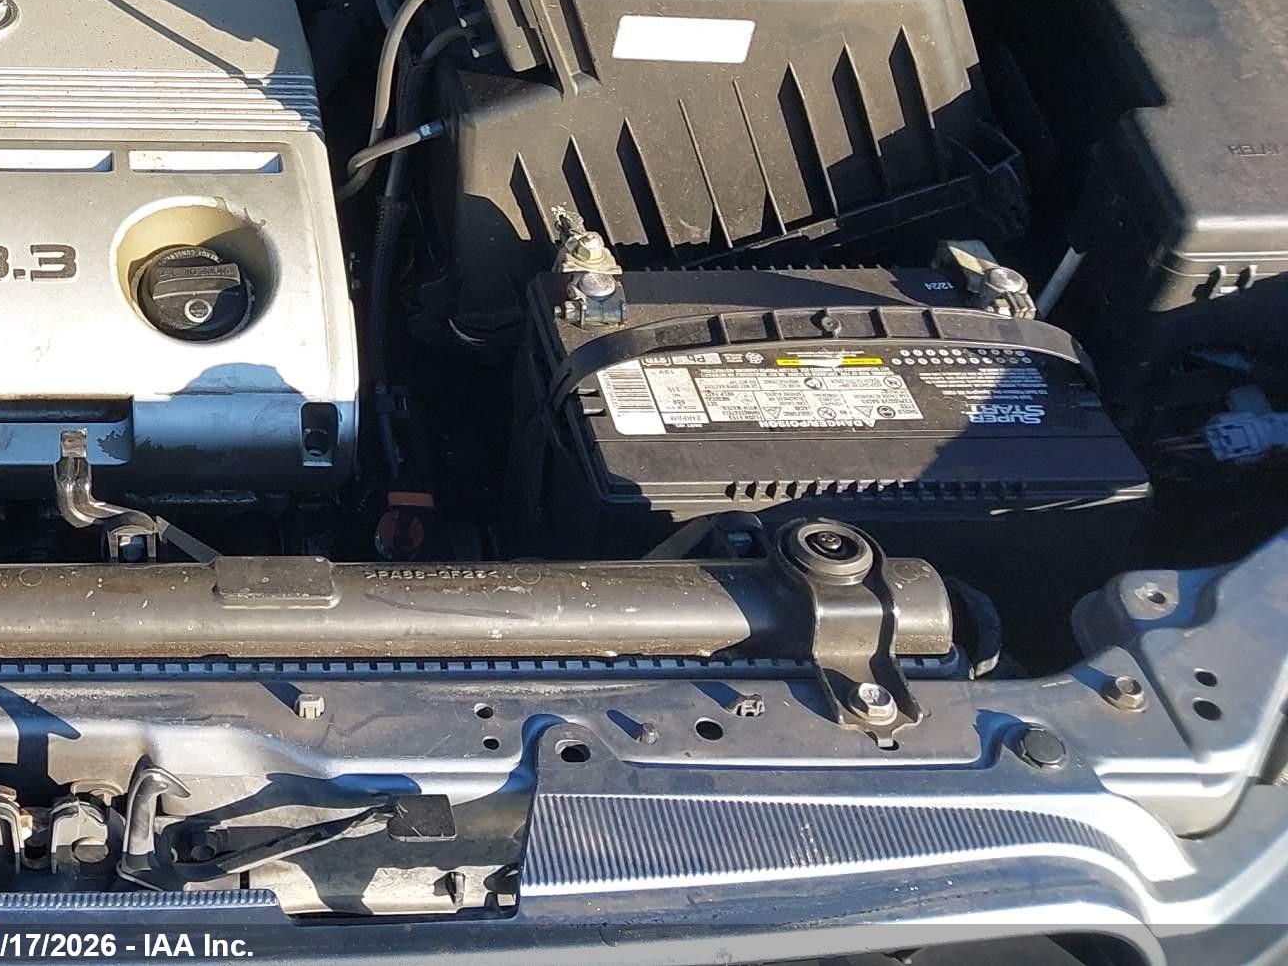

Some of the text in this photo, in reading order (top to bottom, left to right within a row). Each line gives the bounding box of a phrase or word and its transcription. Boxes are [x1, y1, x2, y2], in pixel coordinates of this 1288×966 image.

[962, 405, 1046, 416] START
[758, 420, 864, 428] DANGER/POISON
[969, 414, 1042, 424] SUPER
